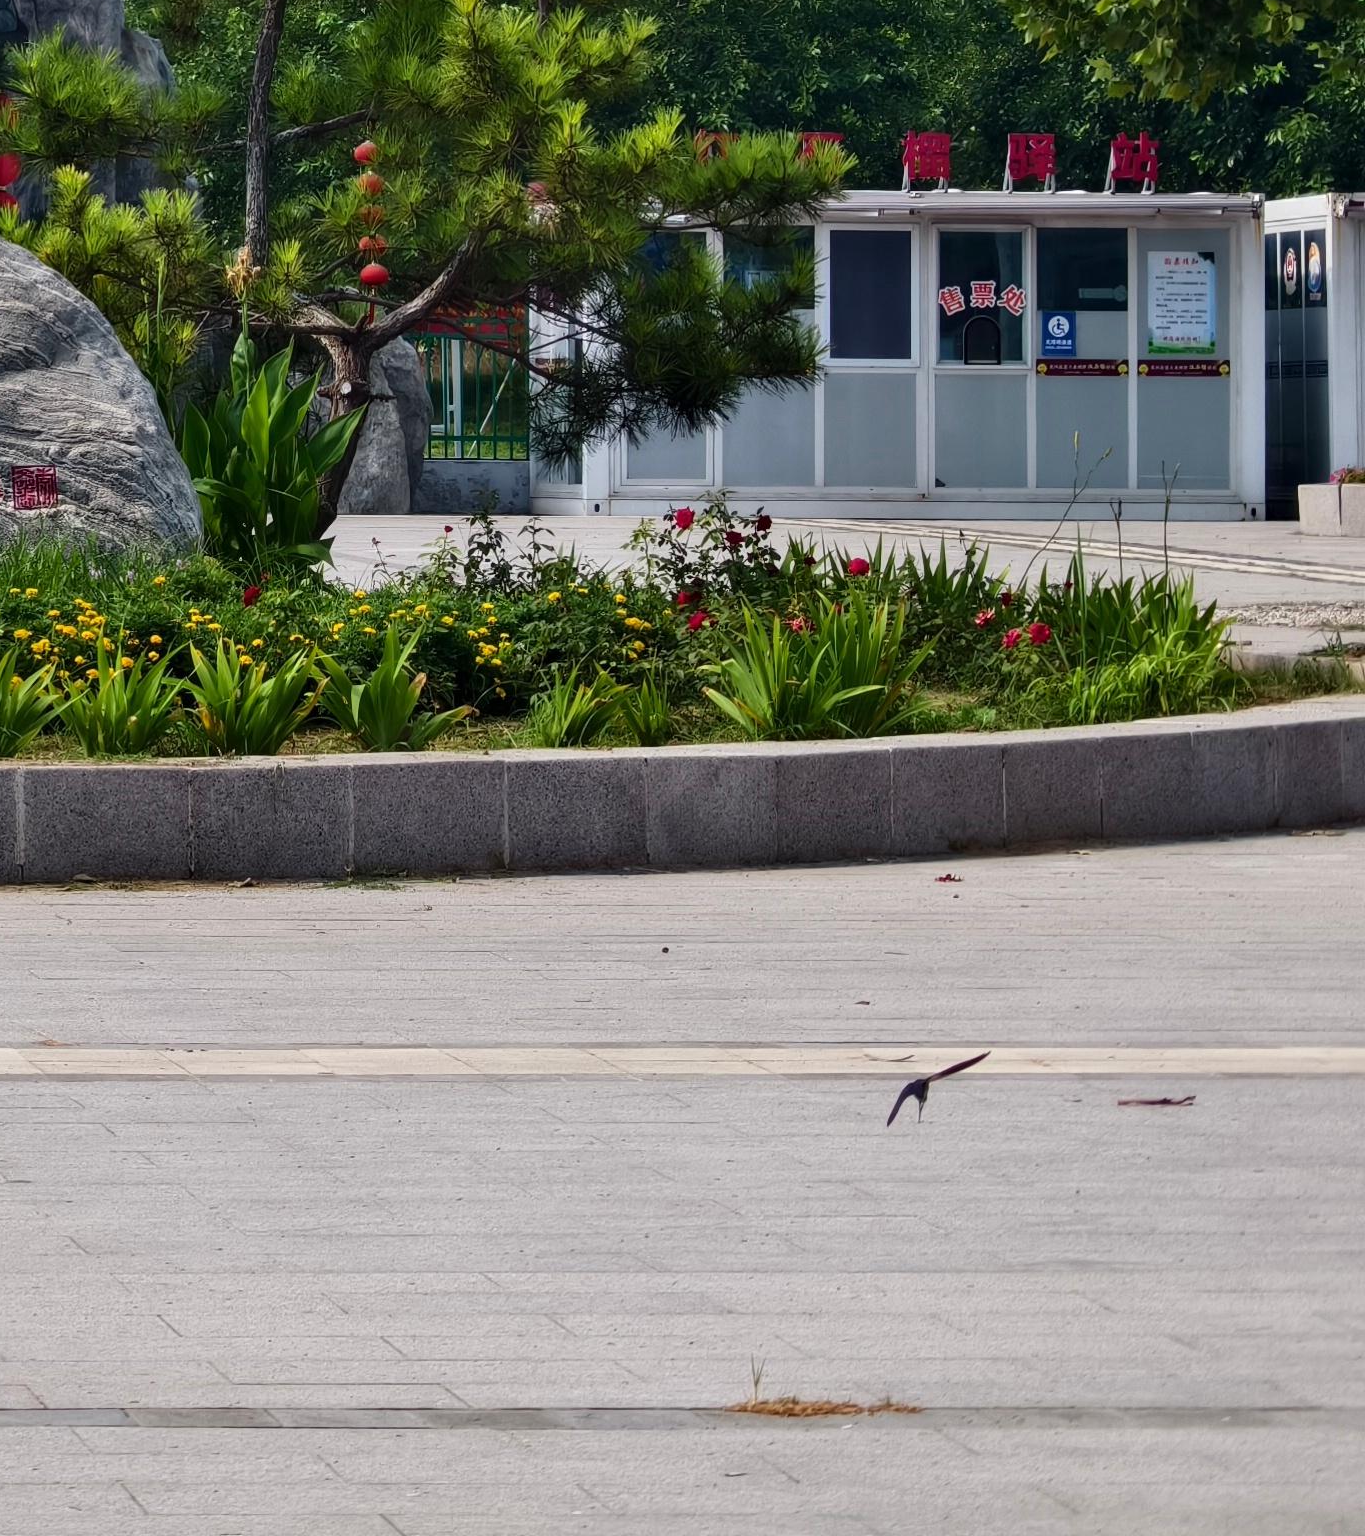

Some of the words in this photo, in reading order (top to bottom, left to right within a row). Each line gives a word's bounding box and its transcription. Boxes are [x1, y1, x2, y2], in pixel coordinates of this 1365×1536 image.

[695, 129, 1160, 183] 榴驿站
[938, 281, 1026, 316] 售票处
